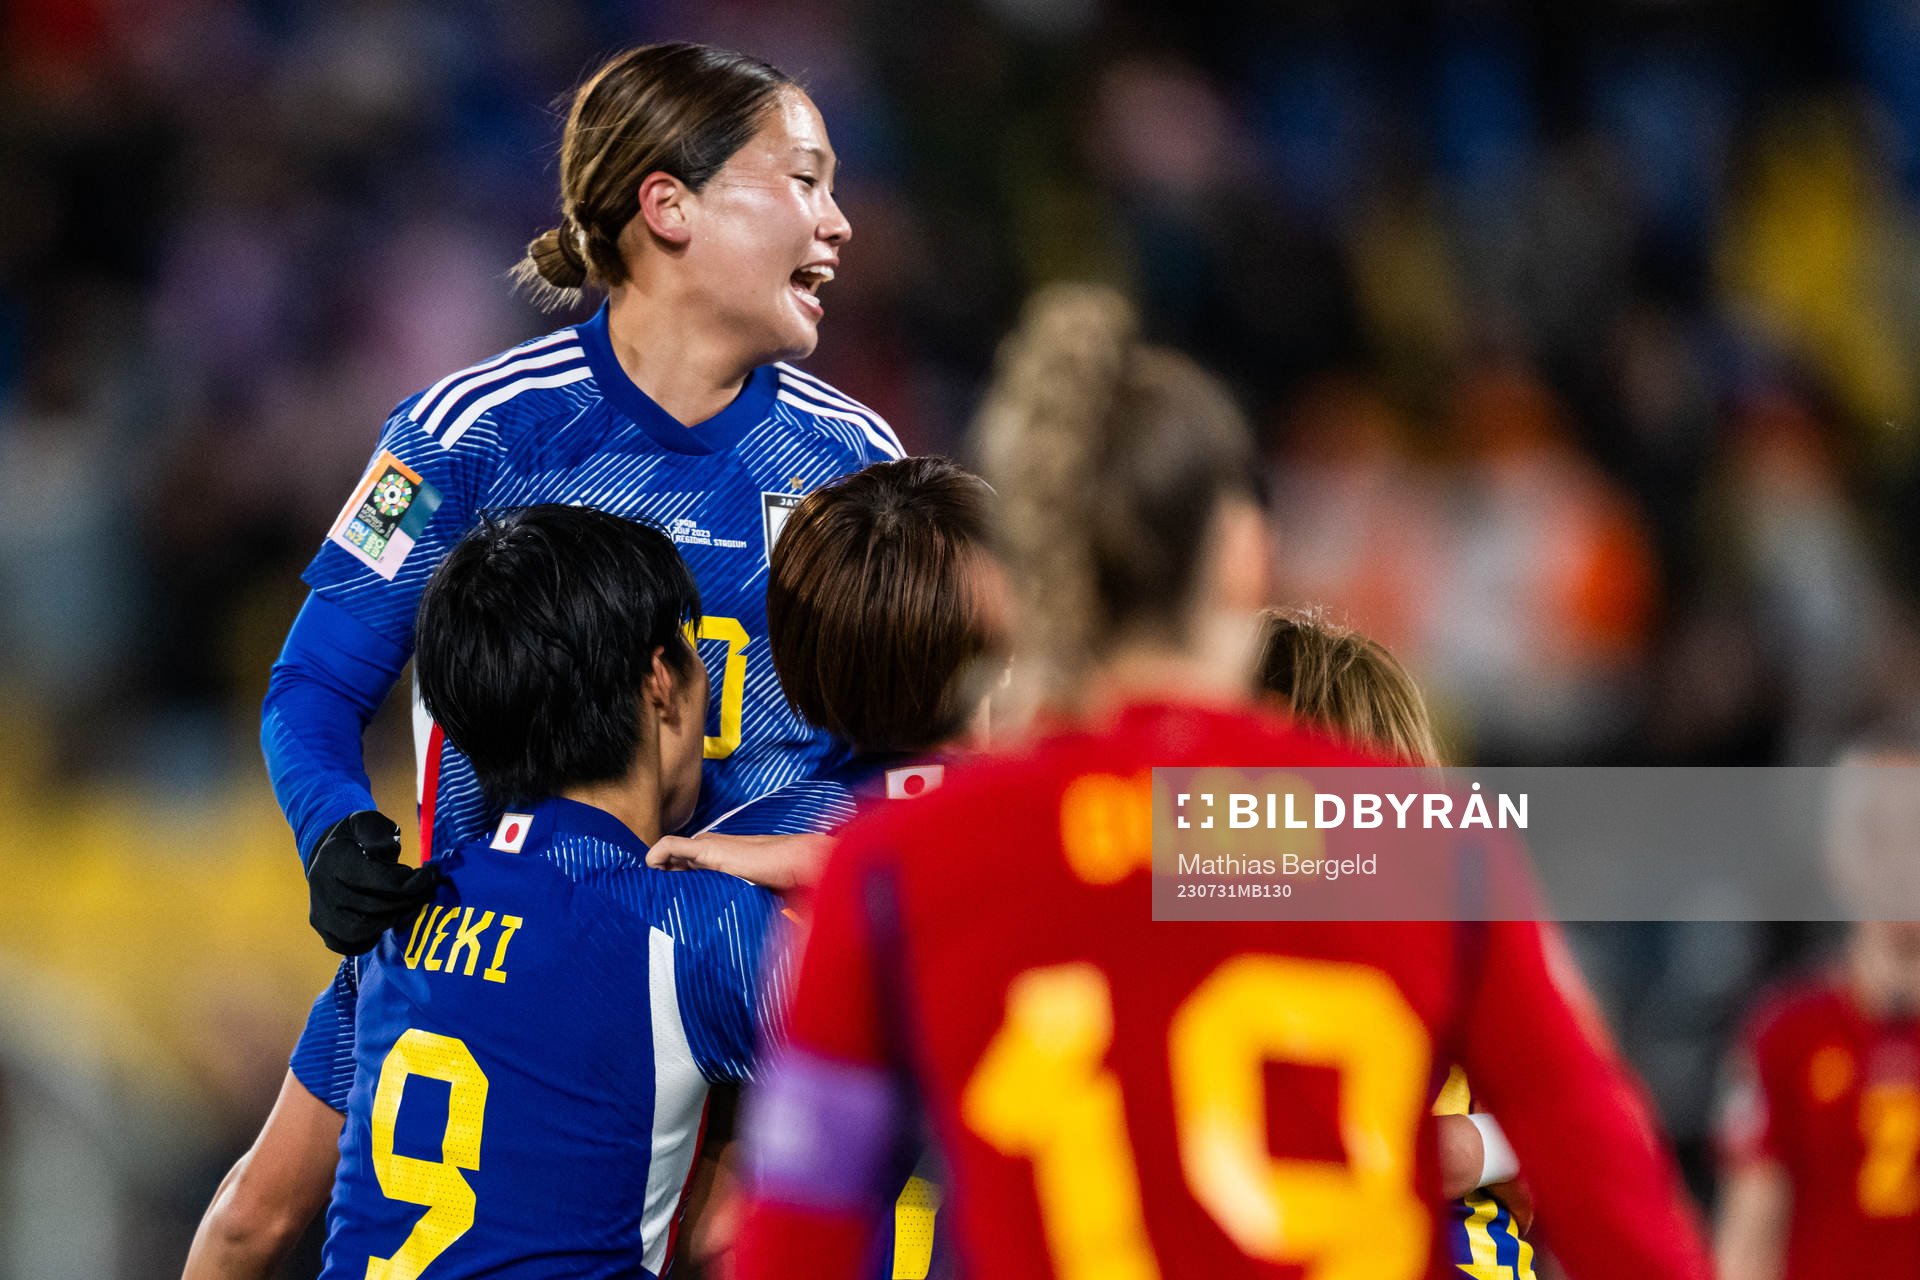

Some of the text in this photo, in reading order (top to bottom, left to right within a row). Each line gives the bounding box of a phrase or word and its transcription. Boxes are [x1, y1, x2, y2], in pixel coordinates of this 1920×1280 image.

[673, 526, 711, 538] JULY 2023
[674, 519, 697, 529] SPAIN
[675, 534, 747, 549] REGIONAL STADIUM
[404, 904, 523, 983] UEKI
[964, 954, 1431, 1280] 19
[366, 1028, 489, 1280] 9
